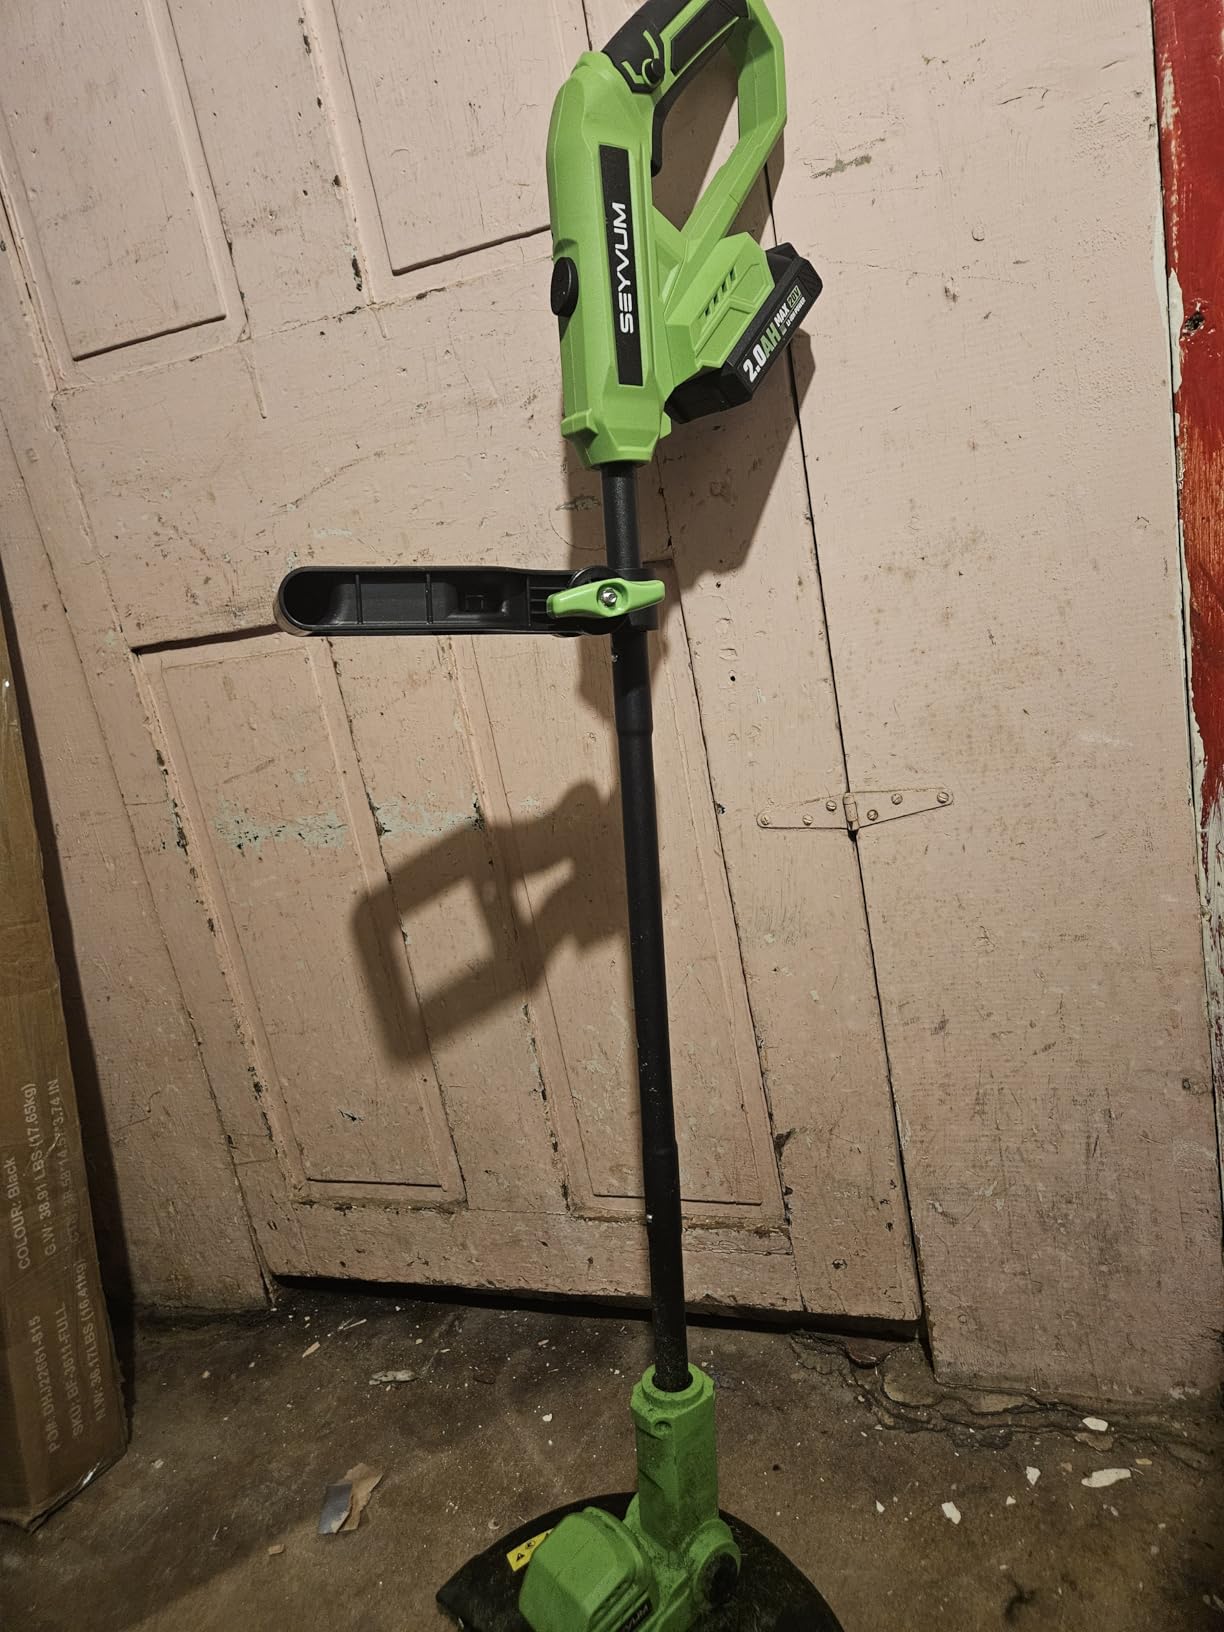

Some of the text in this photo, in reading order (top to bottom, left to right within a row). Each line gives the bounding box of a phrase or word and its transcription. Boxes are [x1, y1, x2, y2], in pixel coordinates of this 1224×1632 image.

[612, 202, 634, 334] SEYVUM
[773, 286, 801, 327] MAX 20V
[743, 322, 782, 383] 2.0AH
[48, 1079, 60, 1094] IN
[21, 1083, 57, 1256] G.W: 38.91 LBS (17.65kg)
[4, 1157, 31, 1270] COLOUR: Black
